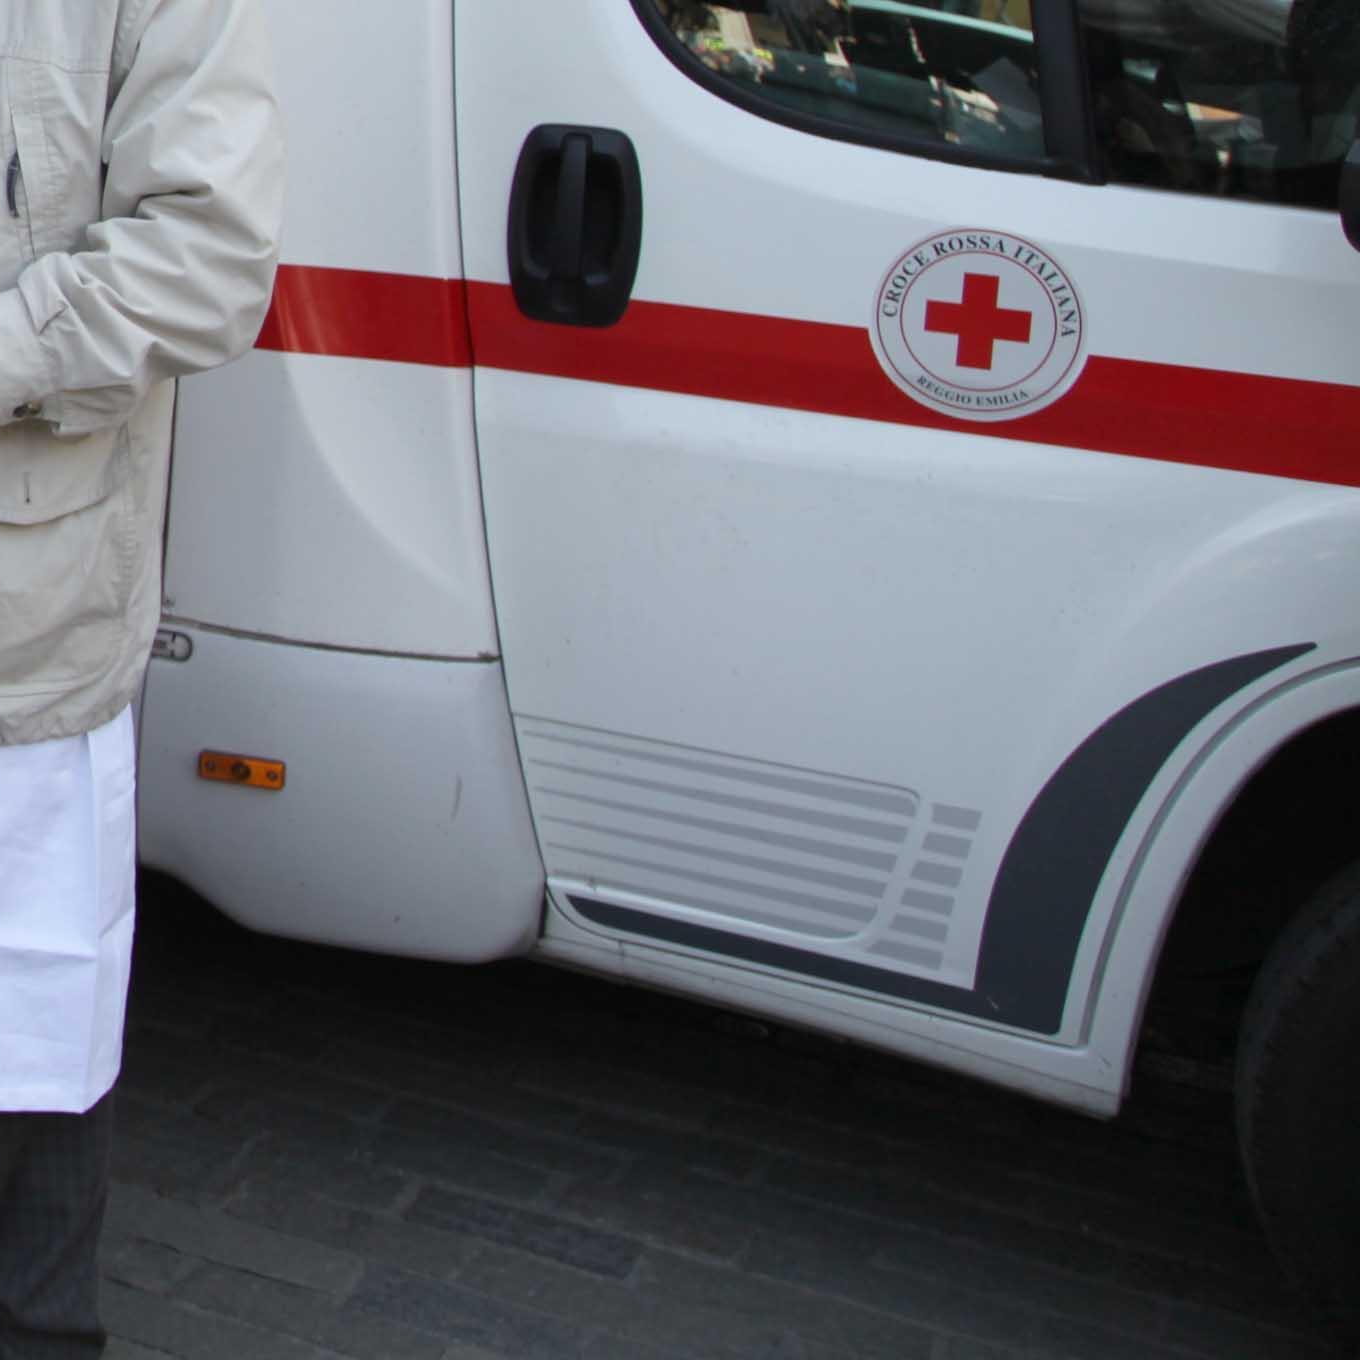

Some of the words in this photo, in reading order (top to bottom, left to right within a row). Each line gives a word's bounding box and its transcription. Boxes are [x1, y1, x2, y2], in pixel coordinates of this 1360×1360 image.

[882, 251, 930, 318] CROCE
[932, 234, 1006, 257] ROSSA
[1013, 245, 1078, 338] ITALIANA
[916, 375, 972, 405] REGGIO
[976, 389, 1029, 407] EMILIA
